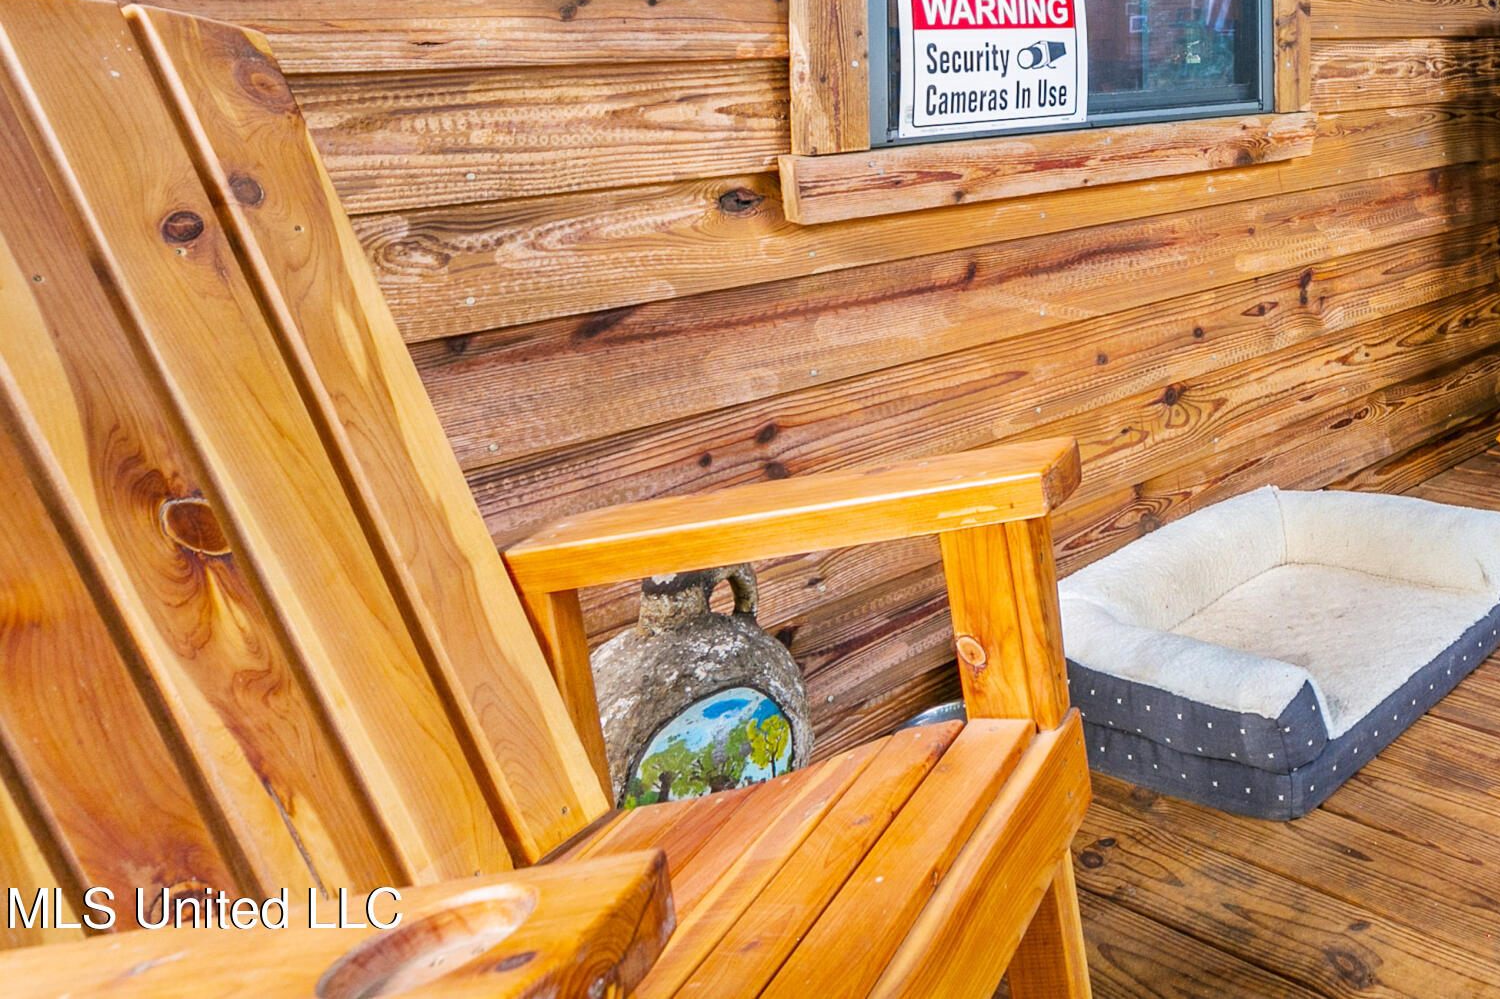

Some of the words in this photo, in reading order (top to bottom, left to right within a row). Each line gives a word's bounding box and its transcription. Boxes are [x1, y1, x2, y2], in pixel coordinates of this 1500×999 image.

[926, 42, 1010, 78] Security
[926, 84, 1008, 116] Cameras
[1015, 80, 1031, 109] In
[1038, 79, 1067, 107] Use
